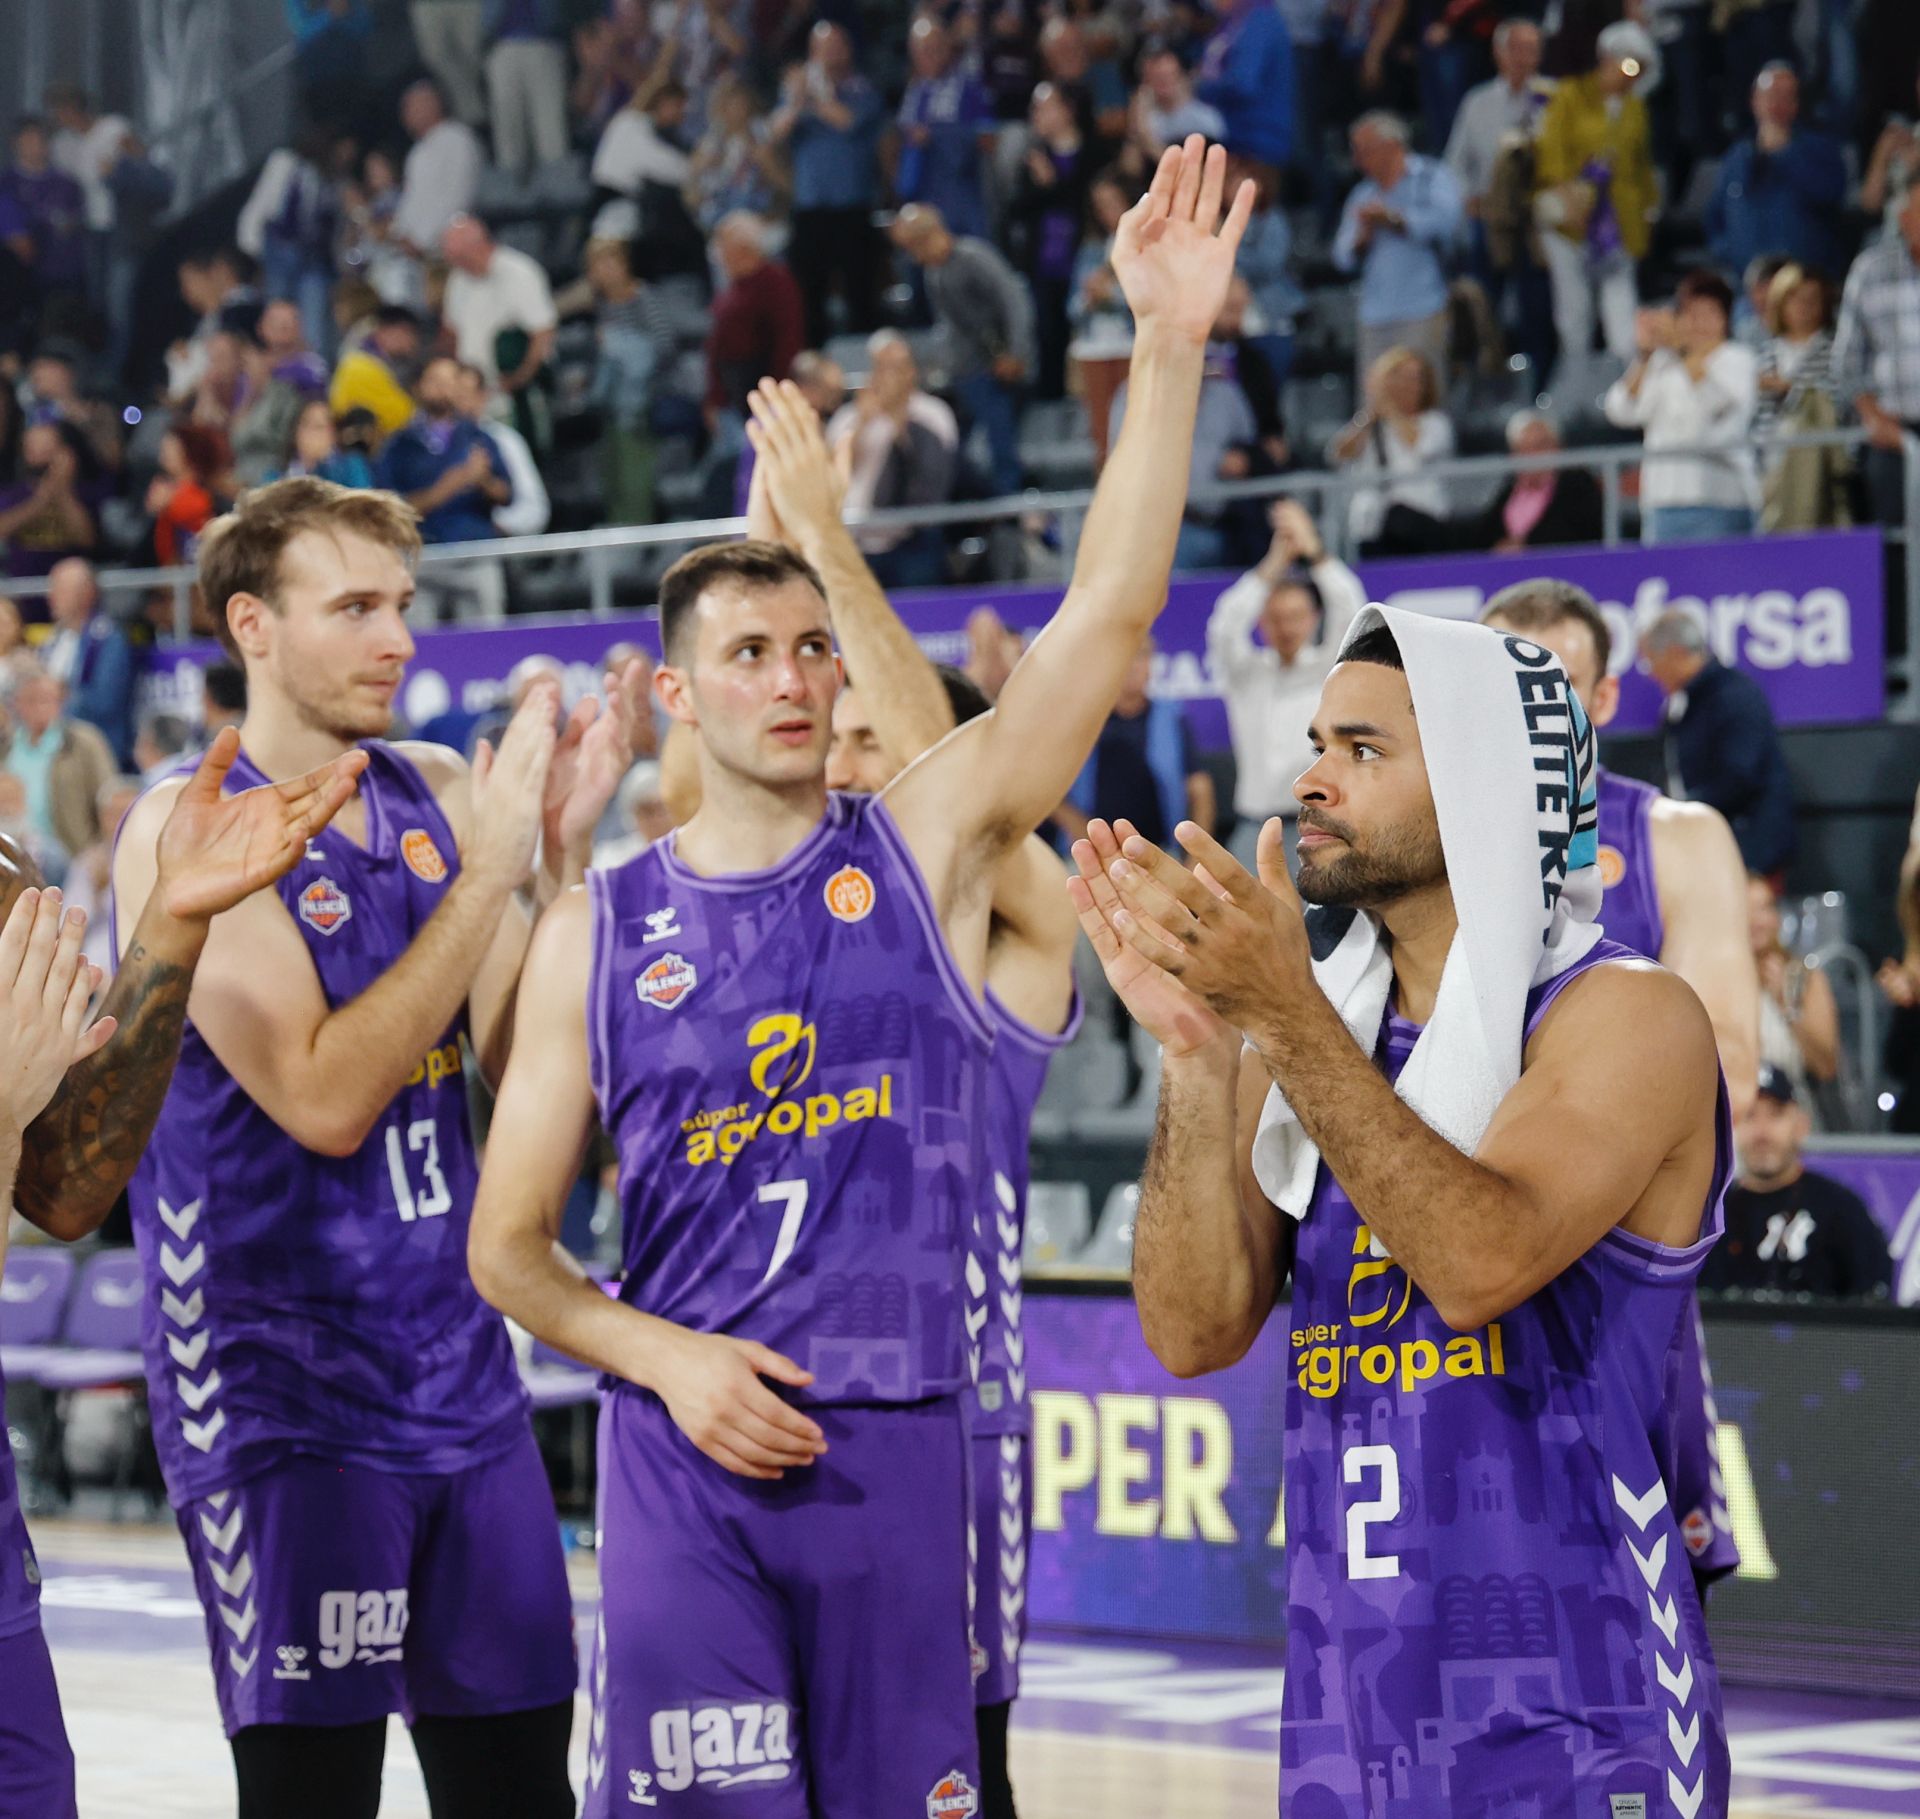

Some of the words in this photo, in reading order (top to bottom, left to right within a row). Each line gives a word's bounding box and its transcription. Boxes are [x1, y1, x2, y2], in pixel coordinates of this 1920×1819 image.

[1503, 634, 1570, 812] OELITE
[385, 1118, 452, 1221] 13
[687, 1074, 892, 1166] agropal
[758, 1178, 809, 1283] 7
[1297, 1323, 1506, 1398] agropal
[1343, 1444, 1401, 1580] 2
[651, 1703, 792, 1791] gaza
